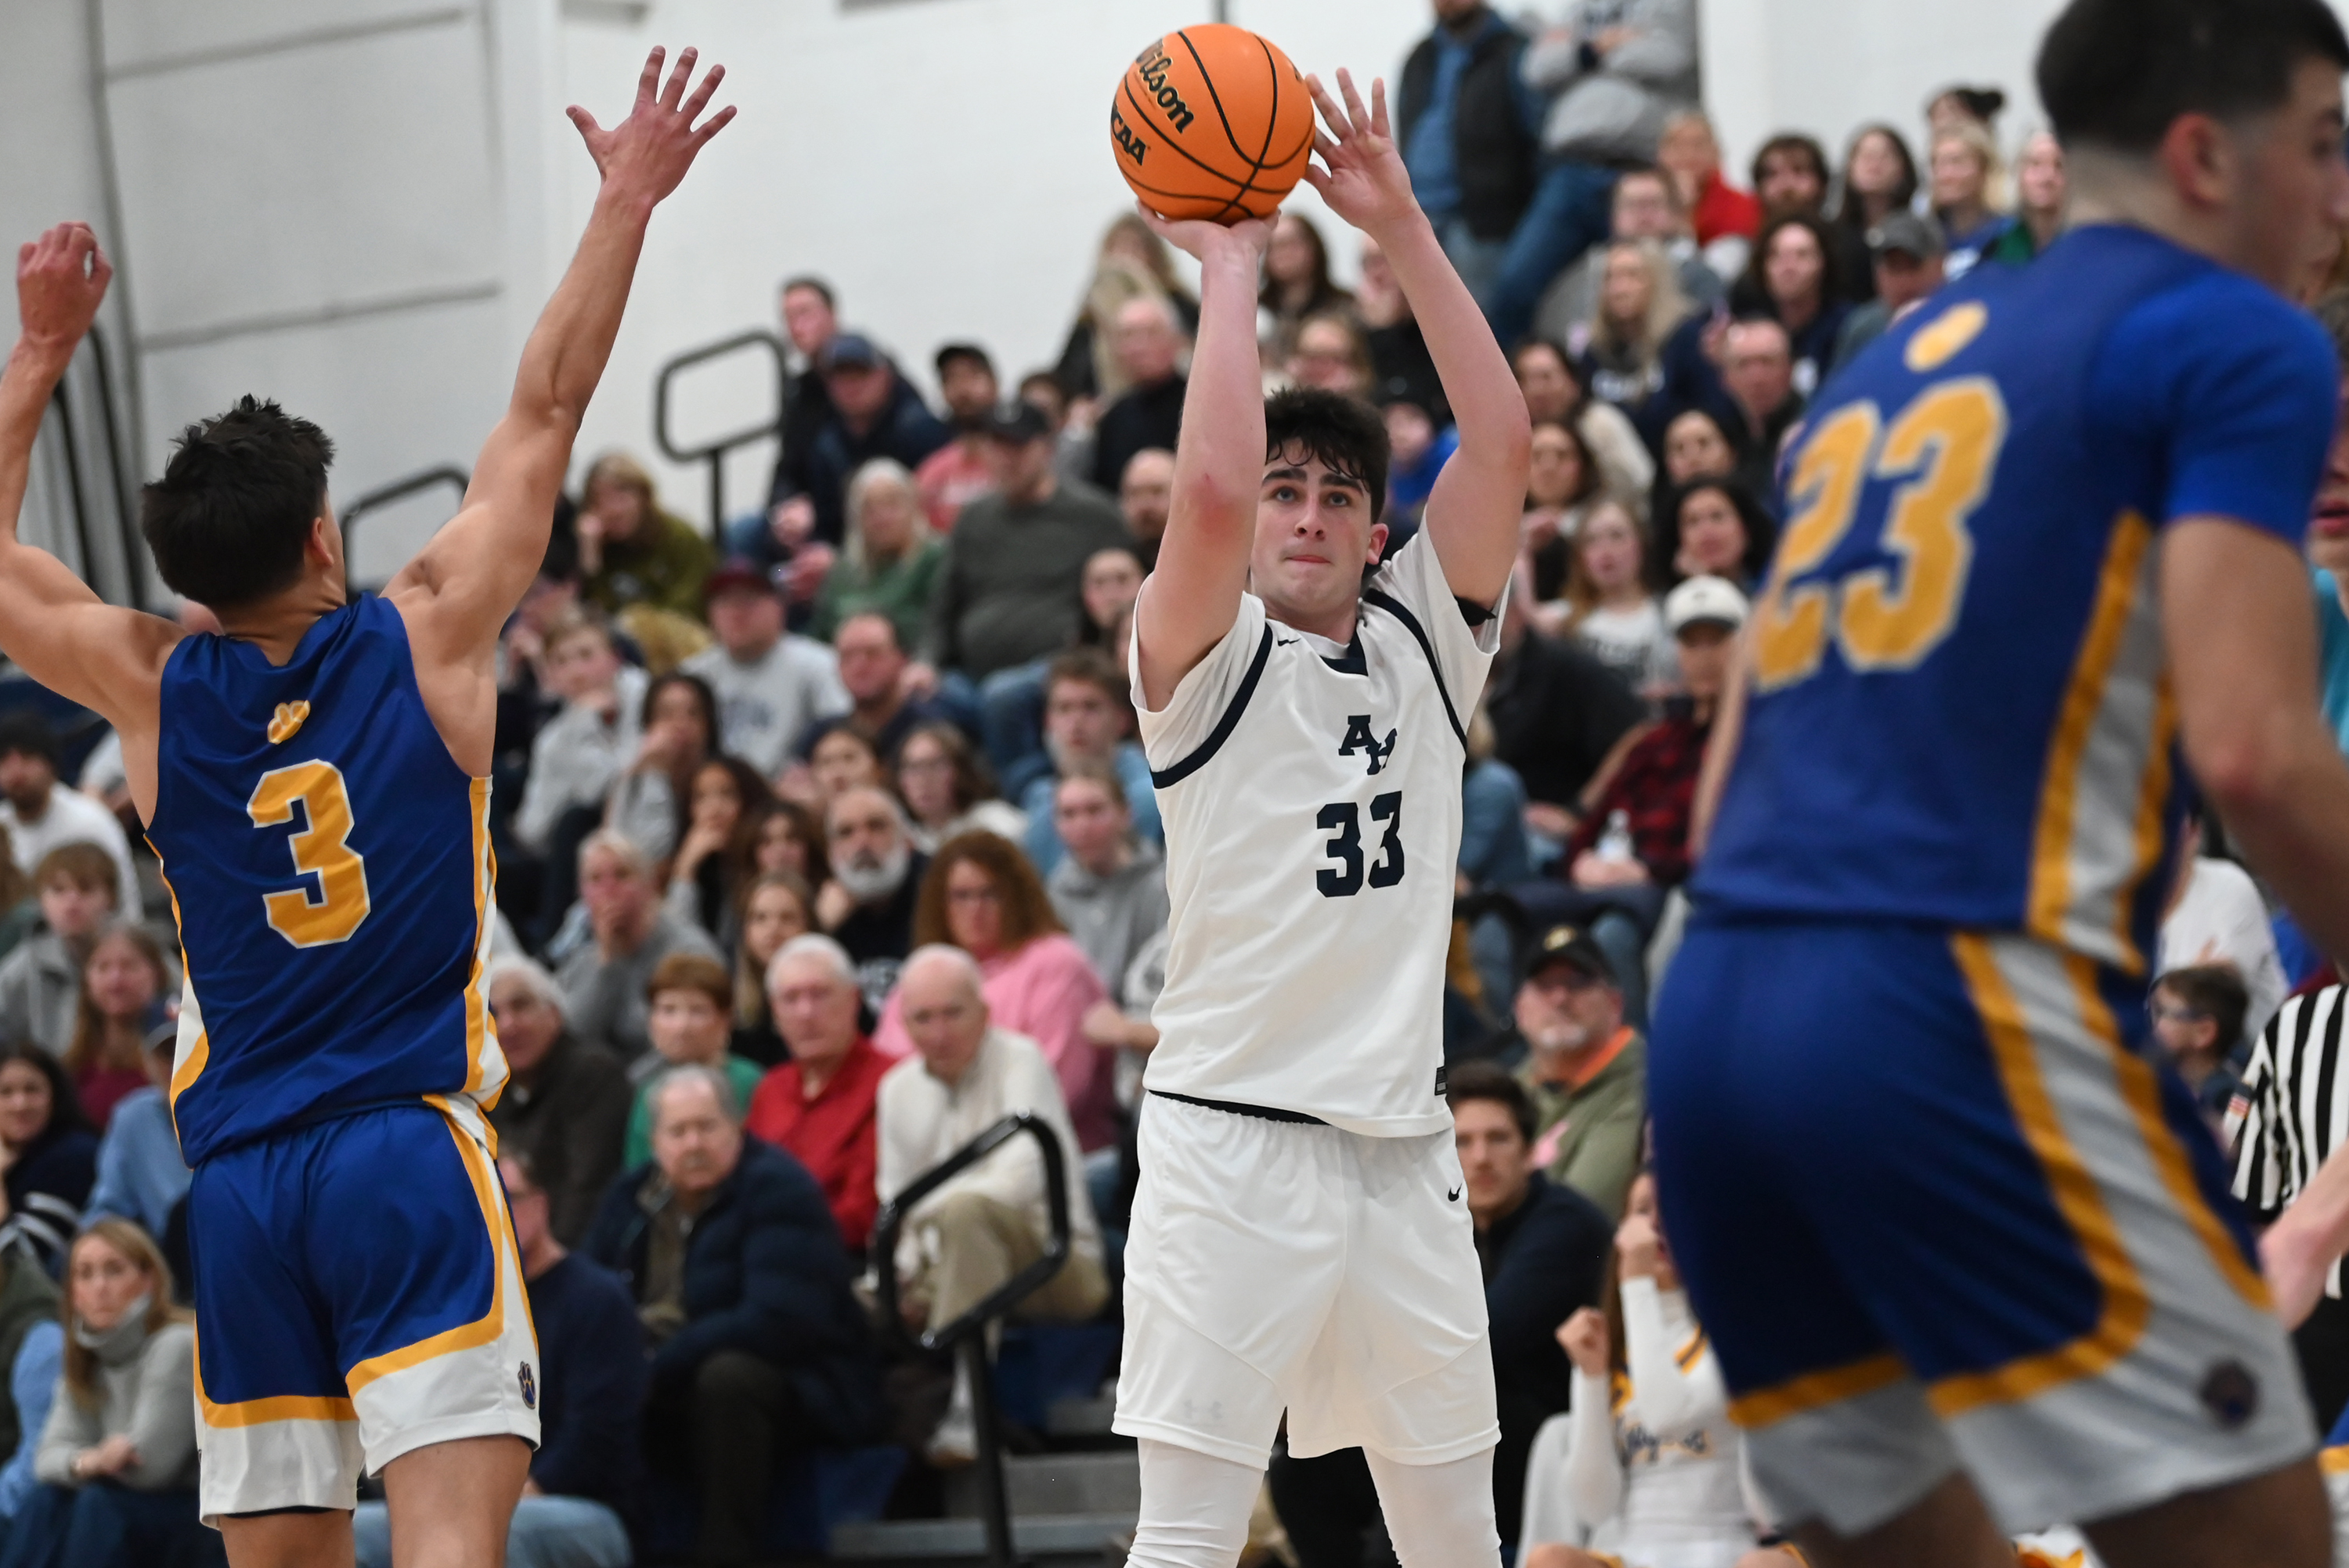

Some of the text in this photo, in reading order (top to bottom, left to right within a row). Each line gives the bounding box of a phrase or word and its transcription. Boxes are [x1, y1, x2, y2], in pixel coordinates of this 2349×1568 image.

[1111, 97, 1146, 166] CAA
[1749, 372, 2011, 697] 23
[247, 758, 371, 949] 3
[1316, 790, 1405, 898] 33
